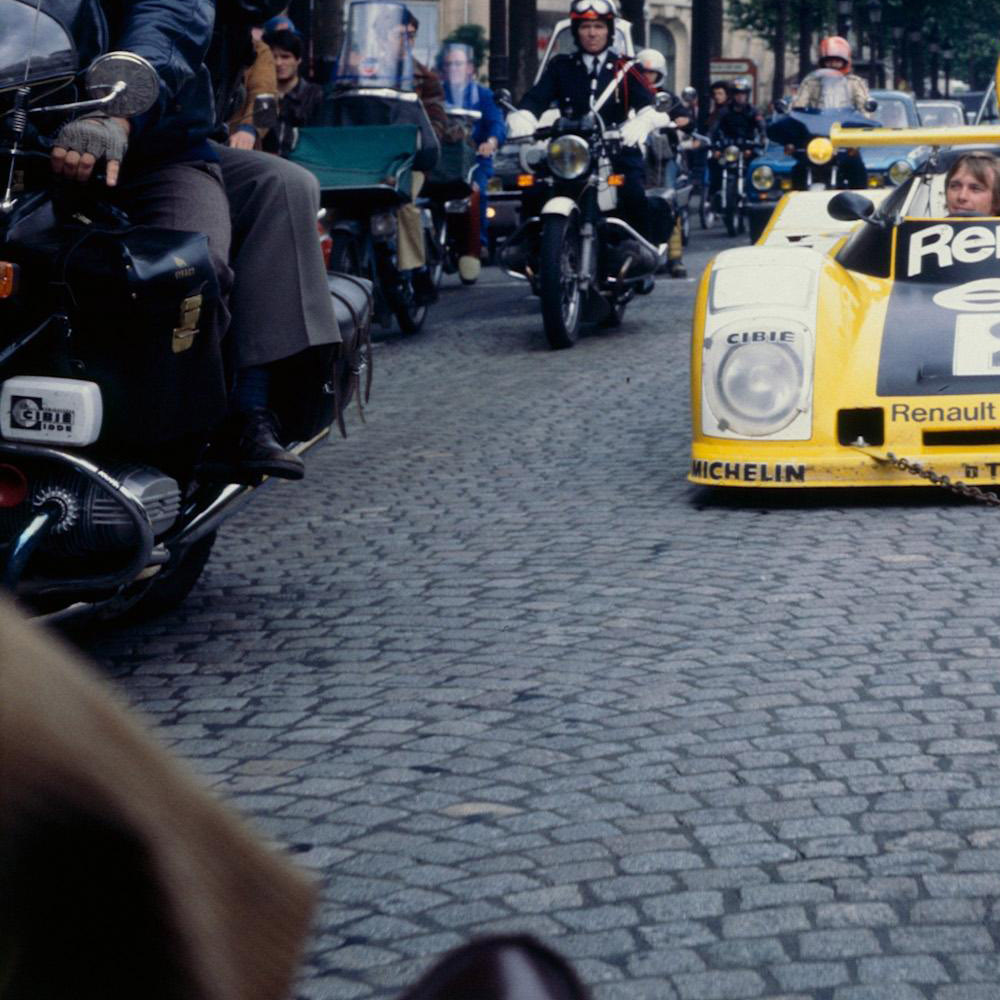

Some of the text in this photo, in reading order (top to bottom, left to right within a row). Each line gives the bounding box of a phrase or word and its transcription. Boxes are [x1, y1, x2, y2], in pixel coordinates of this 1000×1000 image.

[727, 330, 796, 345] CIBIE
[890, 401, 997, 423] Renault
[690, 460, 806, 483] MICHELIN
